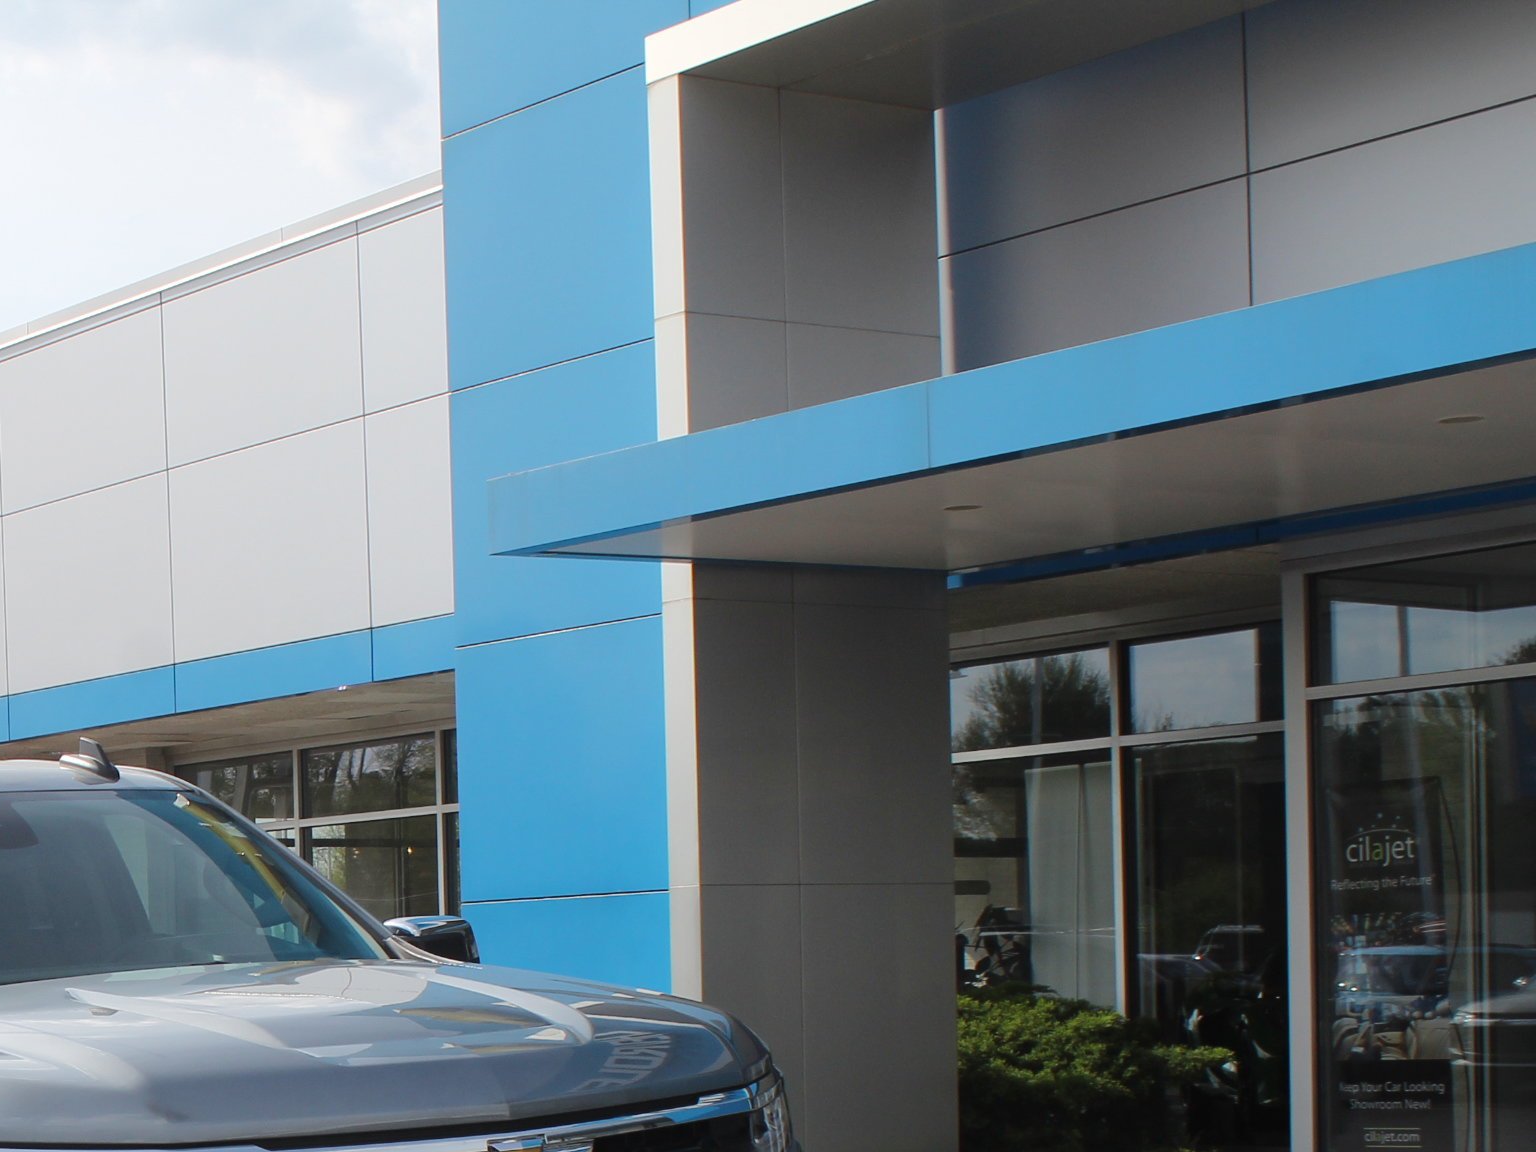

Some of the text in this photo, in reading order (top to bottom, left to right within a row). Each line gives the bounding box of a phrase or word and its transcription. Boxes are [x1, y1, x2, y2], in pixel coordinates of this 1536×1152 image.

[1345, 835, 1415, 867] cilajet
[1330, 878, 1380, 891] Reflecting
[1382, 877, 1398, 888] the
[1361, 1081, 1383, 1093] Your
[1384, 1081, 1401, 1093] Car
[1403, 1081, 1446, 1095] Looking
[1349, 1098, 1403, 1110] Showroom
[1364, 1131, 1421, 1144] cilajet.com
